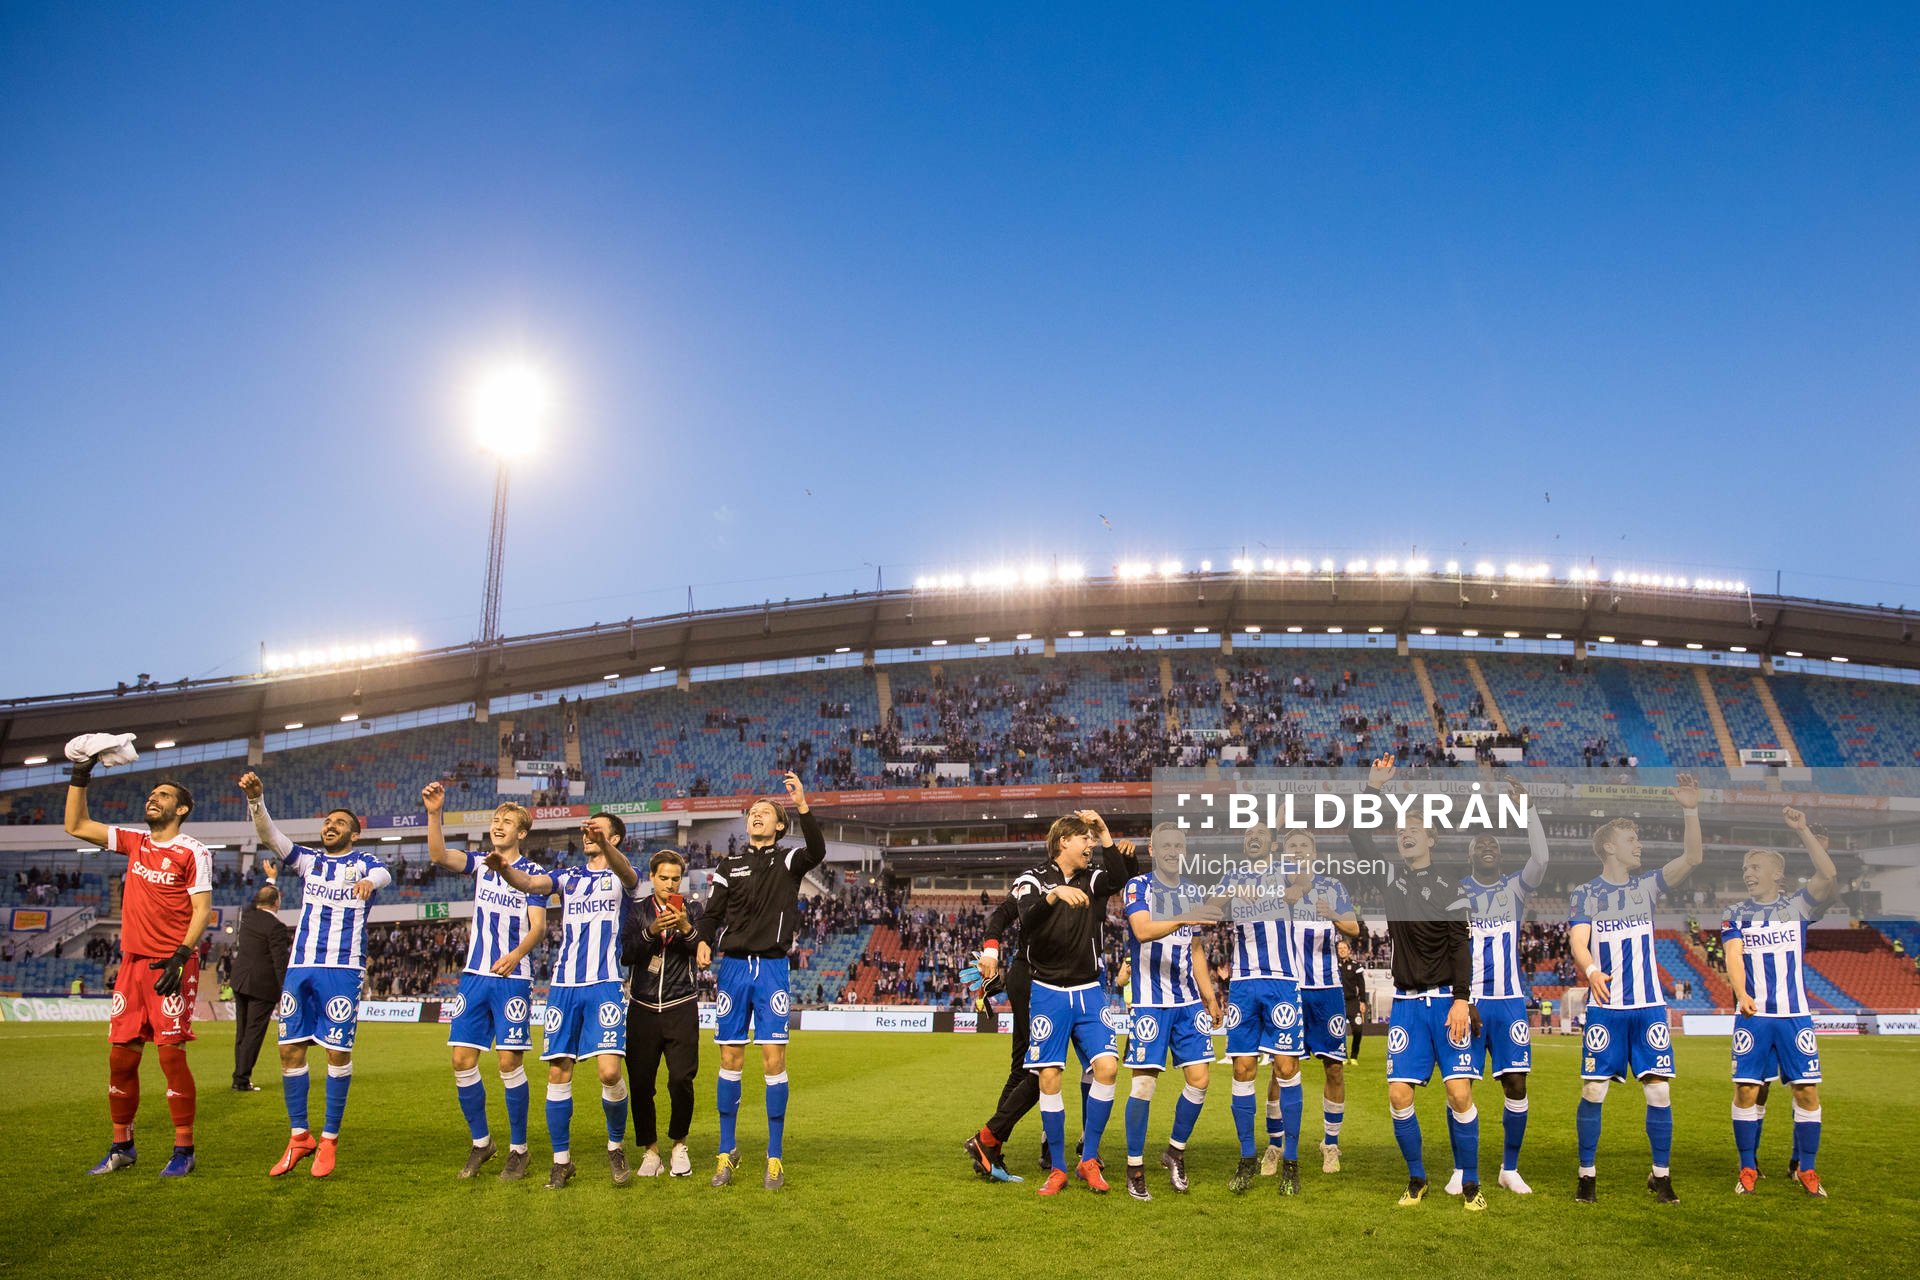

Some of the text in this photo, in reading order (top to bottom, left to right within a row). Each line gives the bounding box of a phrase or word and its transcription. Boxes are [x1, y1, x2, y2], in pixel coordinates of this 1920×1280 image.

[1278, 781, 1317, 793] Ullevi
[1358, 781, 1397, 793] Uevi
[1439, 782, 1473, 793] Ullev
[536, 806, 572, 819] SHOP.
[601, 801, 649, 814] REPEAT.
[392, 815, 419, 827] EAT.
[568, 899, 616, 915] ERNEKE
[1232, 897, 1285, 919] SERNEKE
[1471, 912, 1511, 929] ERNEKE
[1596, 912, 1649, 933] SERNEKE
[366, 1006, 415, 1017] Res med
[172, 1018, 181, 1029] 1
[876, 1017, 927, 1027] Res med
[329, 1027, 343, 1040] 16
[508, 1027, 523, 1039] 14
[603, 1031, 617, 1043] 22
[1278, 1033, 1293, 1045] 26
[1338, 1043, 1346, 1053] 4
[1458, 1054, 1472, 1066] 19
[1523, 1051, 1529, 1062] 3
[1656, 1055, 1671, 1068] 20
[1808, 1060, 1820, 1072] 17
